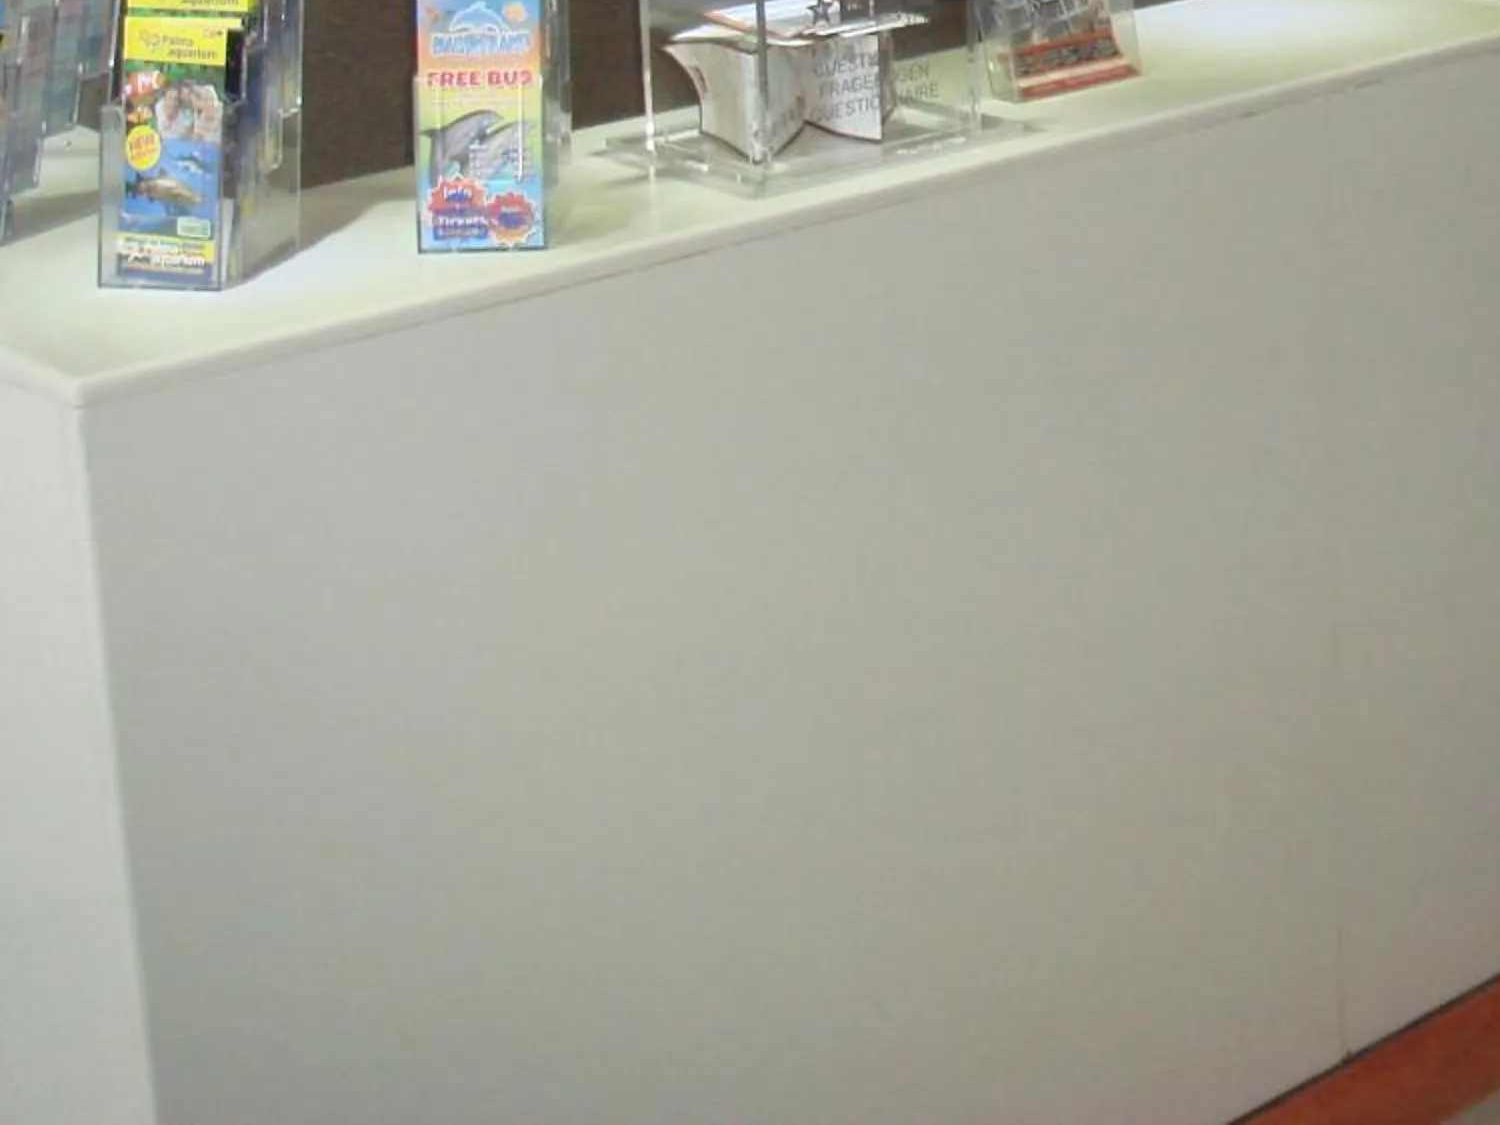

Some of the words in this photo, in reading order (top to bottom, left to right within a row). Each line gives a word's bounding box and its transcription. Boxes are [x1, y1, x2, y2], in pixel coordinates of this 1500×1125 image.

[161, 35, 194, 46] Palma
[167, 47, 218, 60] aquarium
[427, 71, 481, 86] FREE
[487, 69, 533, 85] BUS
